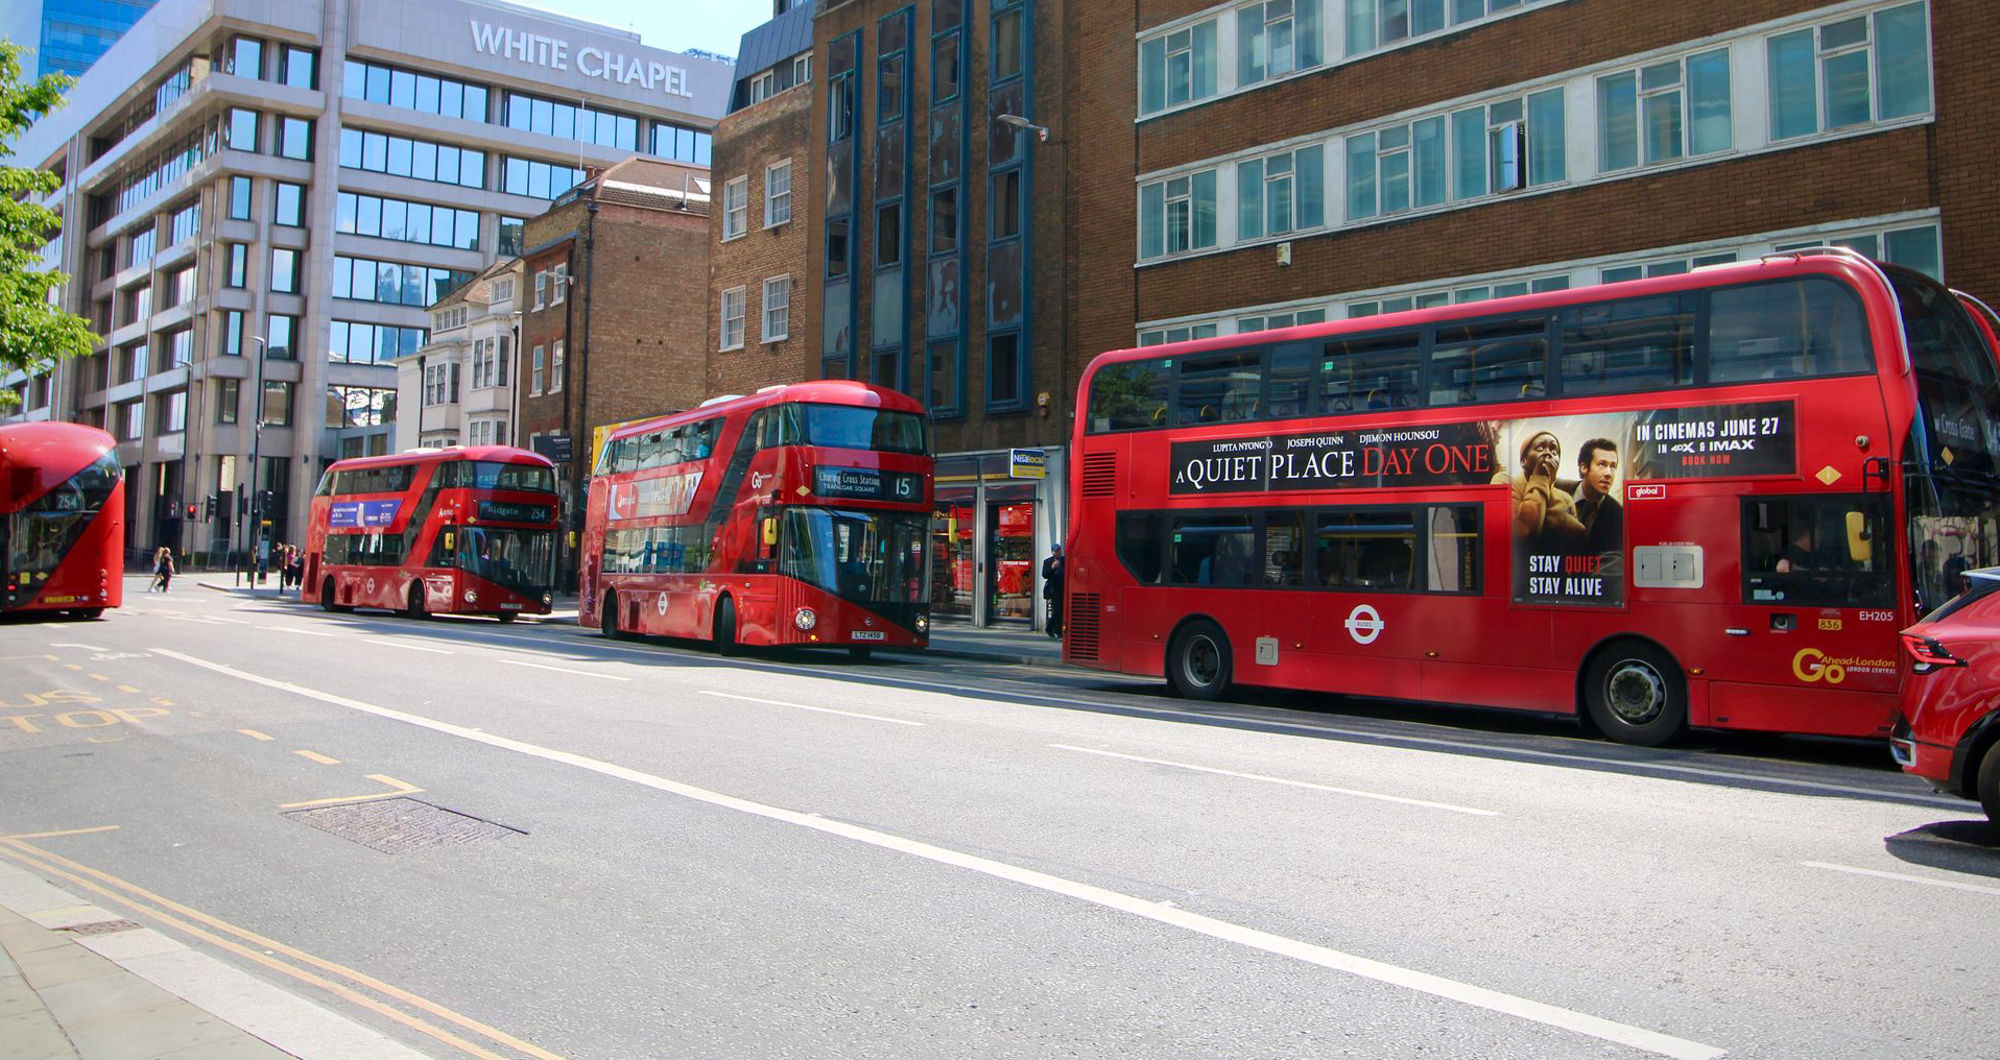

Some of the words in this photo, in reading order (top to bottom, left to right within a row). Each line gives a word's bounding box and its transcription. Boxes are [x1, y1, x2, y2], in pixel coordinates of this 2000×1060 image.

[470, 20, 567, 70] WHITE
[577, 47, 694, 99] CHAPEL
[1637, 425, 1650, 441] IN
[1654, 421, 1715, 440] CINEMAS
[1720, 418, 1757, 437] JUNE
[1761, 417, 1780, 435] 27
[1287, 438, 1315, 450] JOSEPH
[1316, 436, 1344, 448] QUINN
[1359, 433, 1393, 445] DJIMON
[1394, 430, 1440, 442] HOUNSOU
[1213, 443, 1238, 453] LUPITA
[1238, 440, 1273, 451] NYONG'O
[1658, 444, 1667, 454] IN
[1670, 441, 1695, 453] 4DX
[1709, 439, 1755, 452] IMAX
[1175, 470, 1185, 484] A
[1187, 456, 1262, 489] QUIET
[1270, 450, 1355, 480] PLACE
[1362, 446, 1419, 477] DAY
[1424, 443, 1490, 475] ONE
[1682, 455, 1706, 466] BOOK
[1709, 453, 1731, 465] NOW
[819, 472, 841, 485] Charing
[842, 472, 859, 485] Cross
[859, 475, 880, 487] Station
[896, 477, 910, 496] 15
[854, 485, 875, 493] SQUARE
[1635, 487, 1658, 497] global
[57, 494, 78, 509] 254
[1529, 555, 1560, 573] STAY
[1565, 555, 1602, 575] QUIET
[1529, 577, 1561, 594] STAY
[1565, 578, 1602, 596] ALIVE
[1859, 611, 1894, 622] EH205
[1820, 620, 1840, 630] 836
[1792, 648, 1845, 684] Go
[1846, 665, 1870, 673] LONDON
[0, 690, 103, 708] US
[0, 708, 170, 733] TOP
